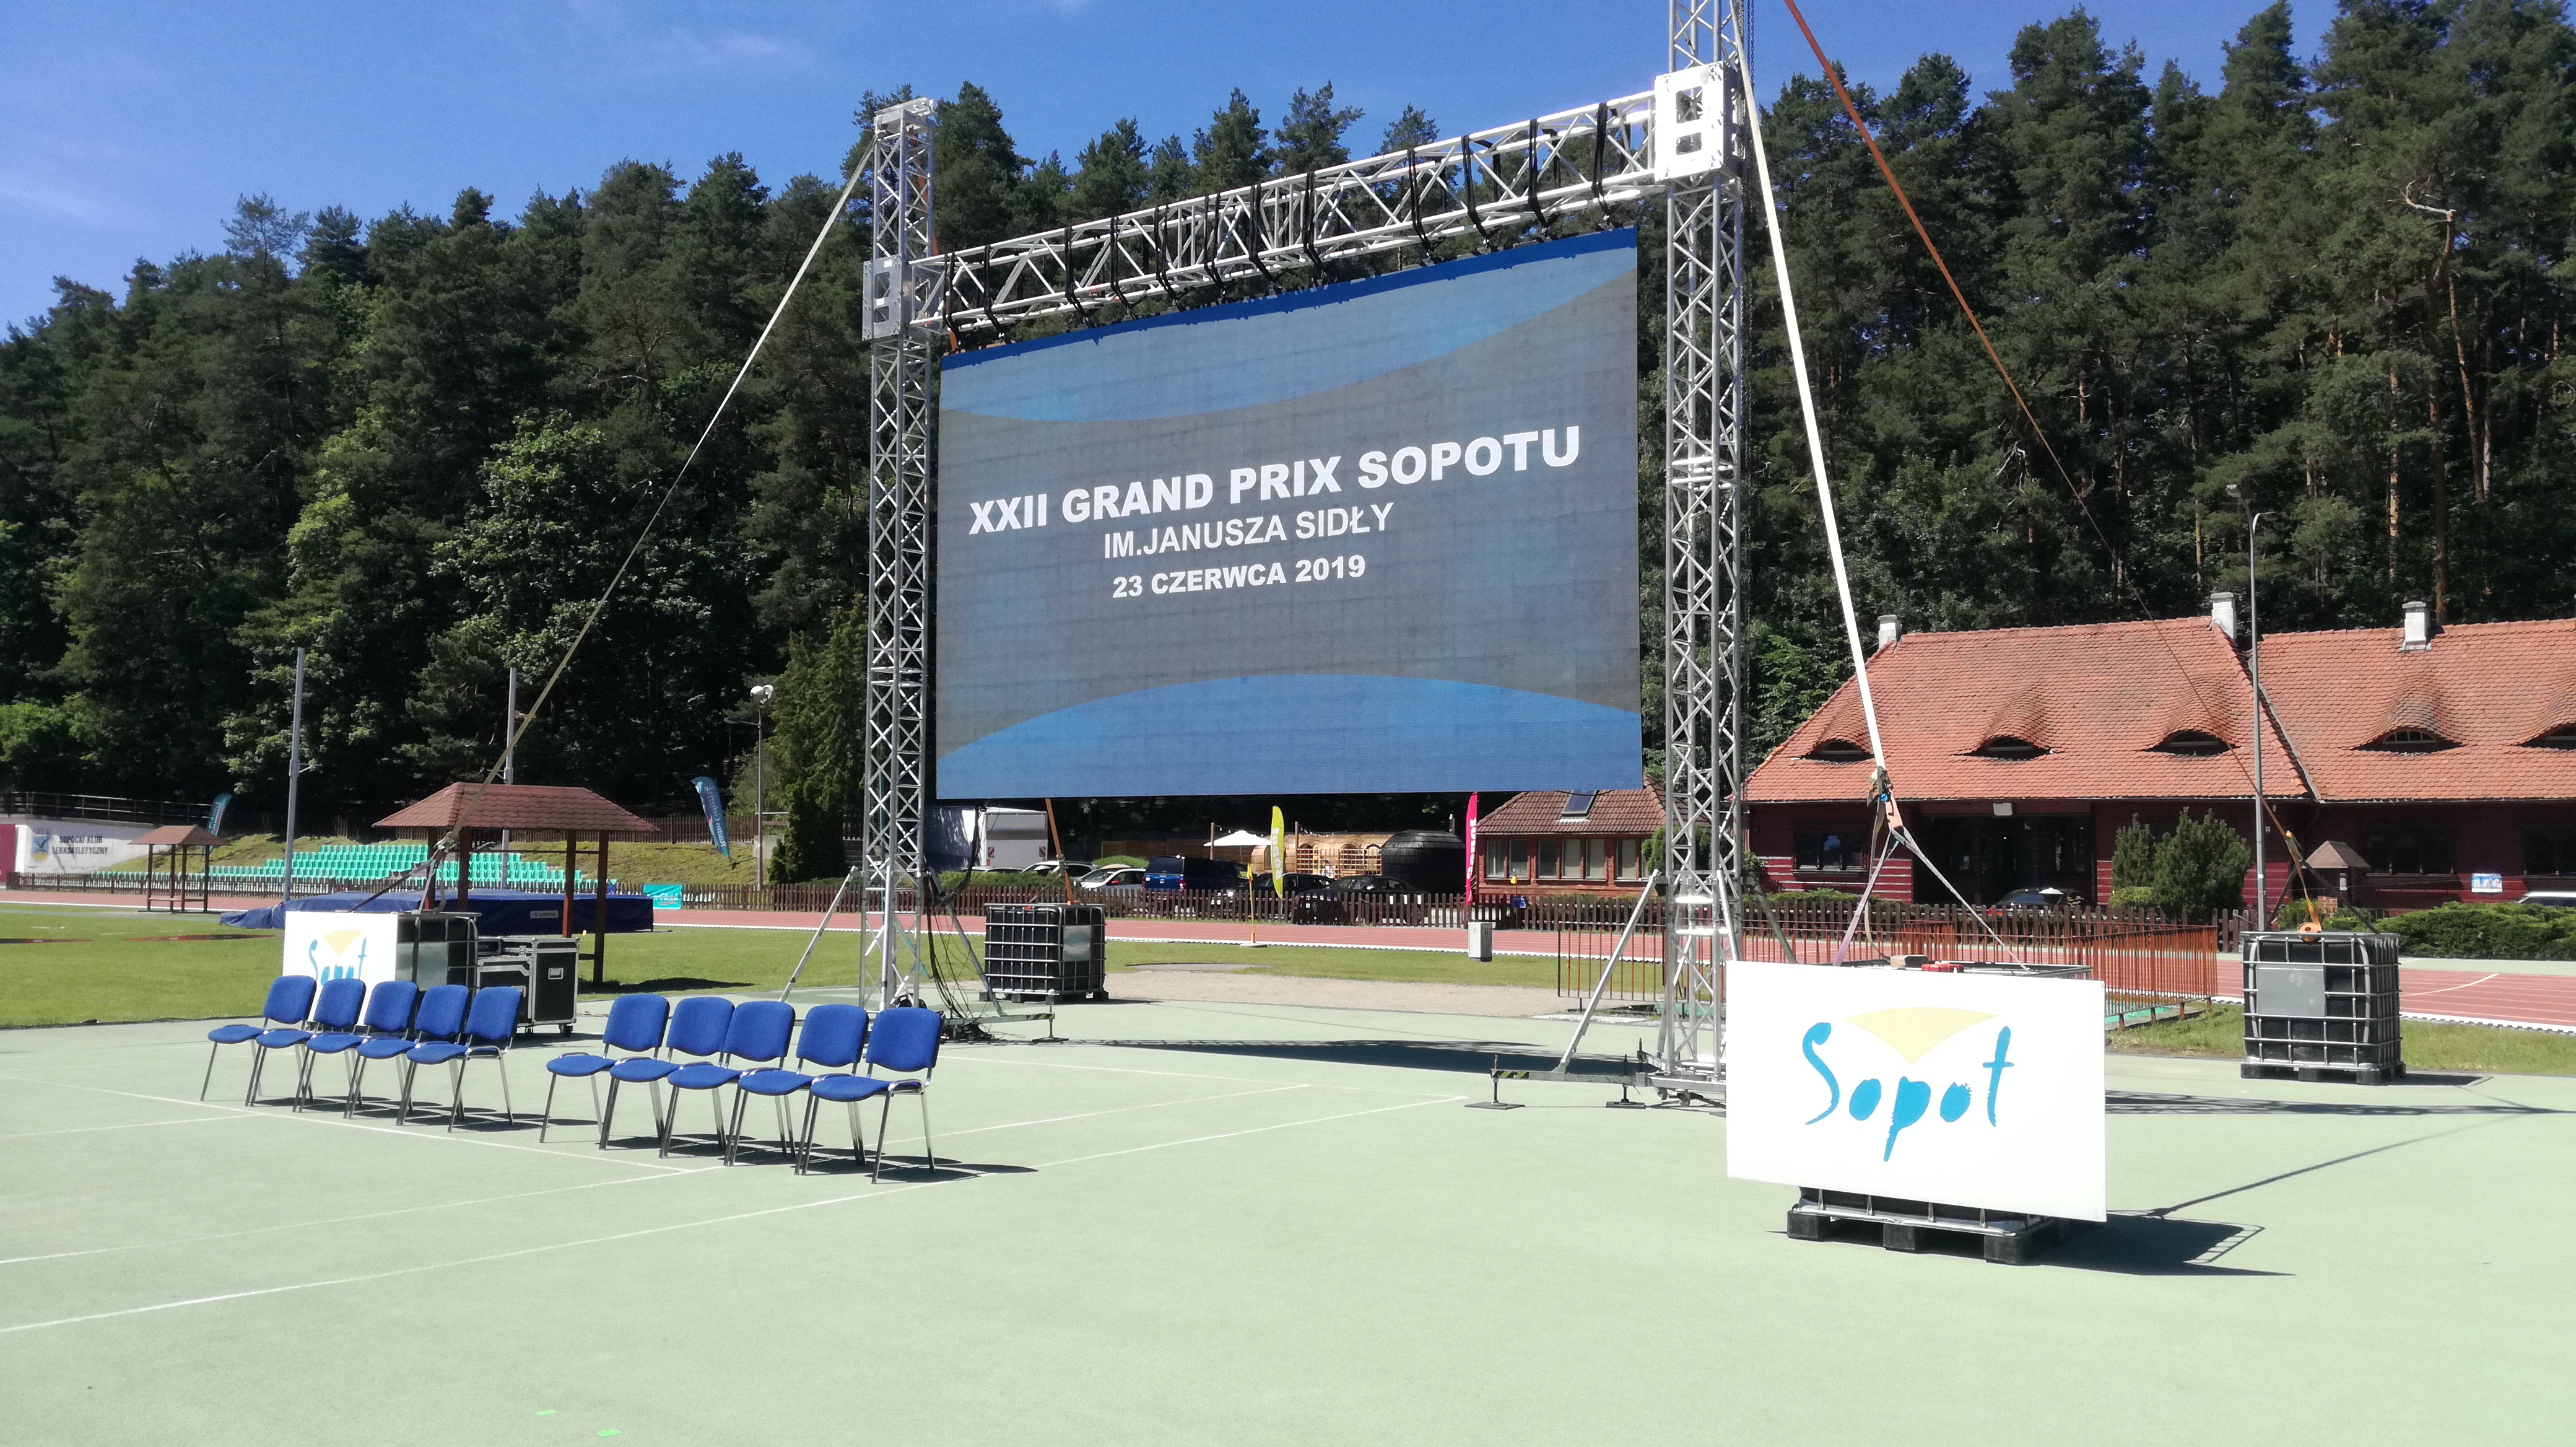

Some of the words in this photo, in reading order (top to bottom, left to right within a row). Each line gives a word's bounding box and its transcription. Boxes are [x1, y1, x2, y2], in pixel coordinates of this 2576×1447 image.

[969, 494, 1047, 535] XXII
[1062, 474, 1213, 523] GRAND
[1230, 456, 1342, 504] PRIX
[1357, 426, 1580, 489] SOPOTU
[1105, 515, 1287, 559] IM.JANUSZA
[1295, 502, 1394, 539] SIDŁY
[1112, 575, 1143, 598] 23
[1151, 562, 1287, 595] CZERWCA
[1295, 554, 1365, 582] 2019
[52, 846, 108, 855] LEKKOATLETYCZNY
[1802, 1022, 2014, 1162] Sopot
